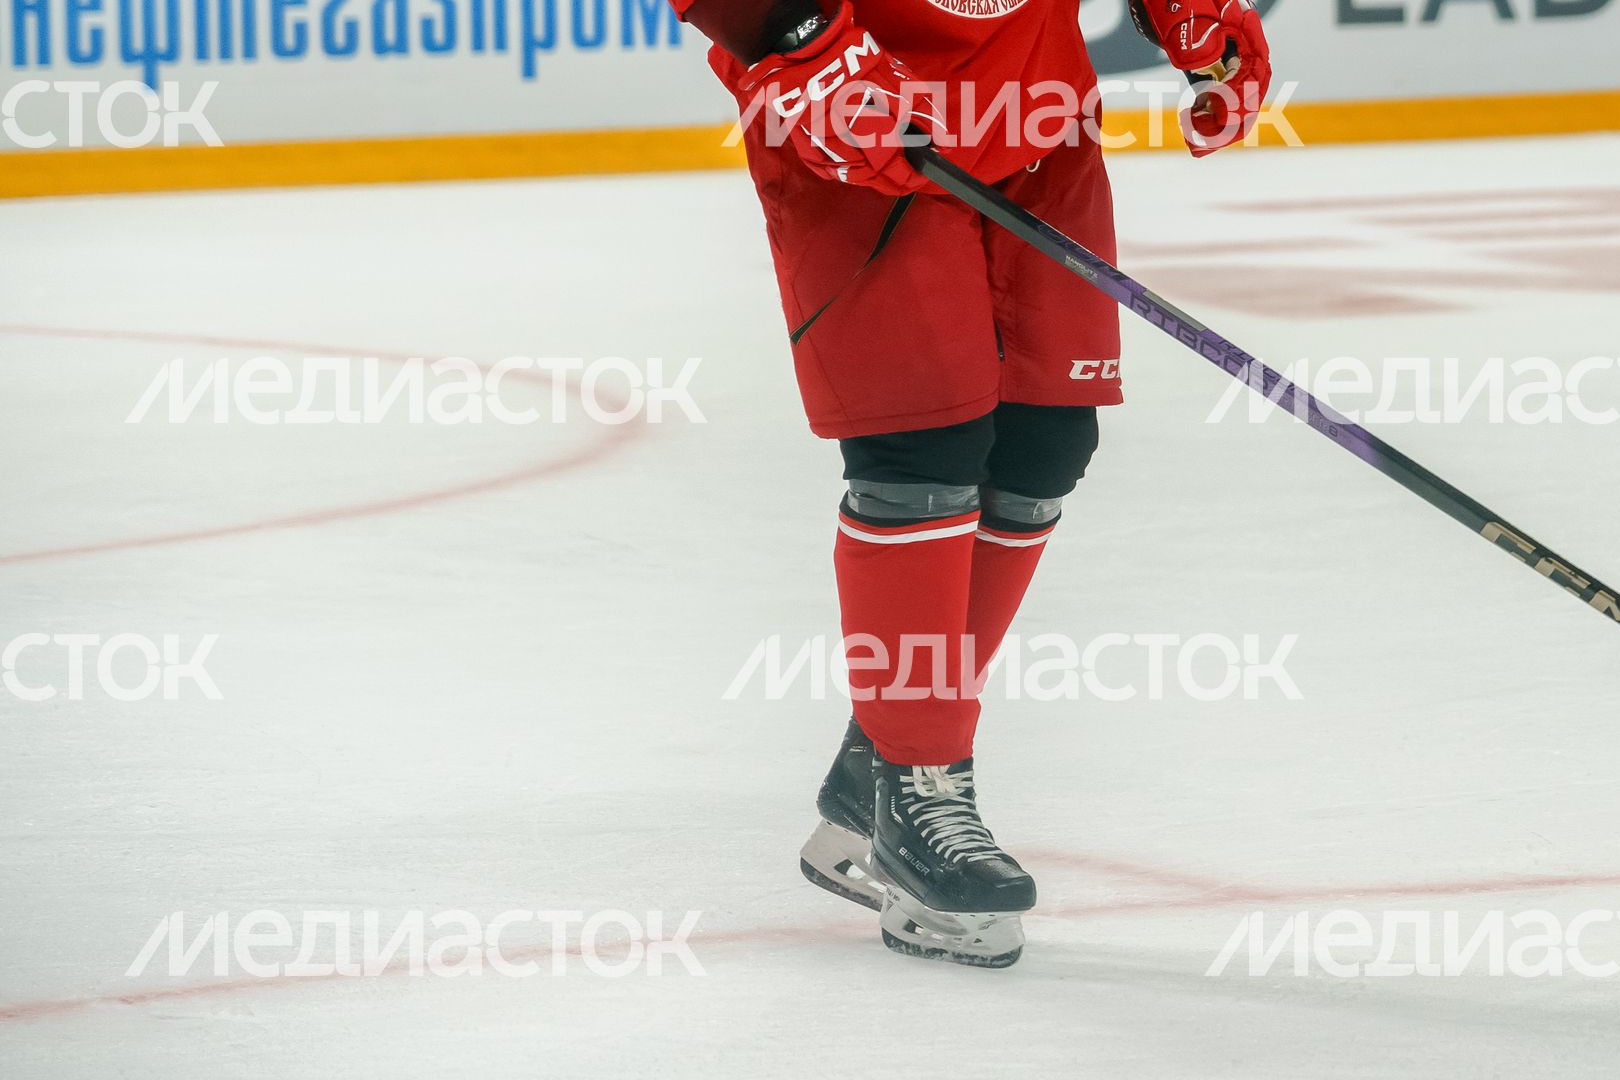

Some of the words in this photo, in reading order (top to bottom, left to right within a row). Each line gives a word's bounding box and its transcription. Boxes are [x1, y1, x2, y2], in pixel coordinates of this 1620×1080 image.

[1180, 22, 1188, 50] CCM
[772, 31, 881, 118] CCM
[1068, 359, 1122, 381] CC
